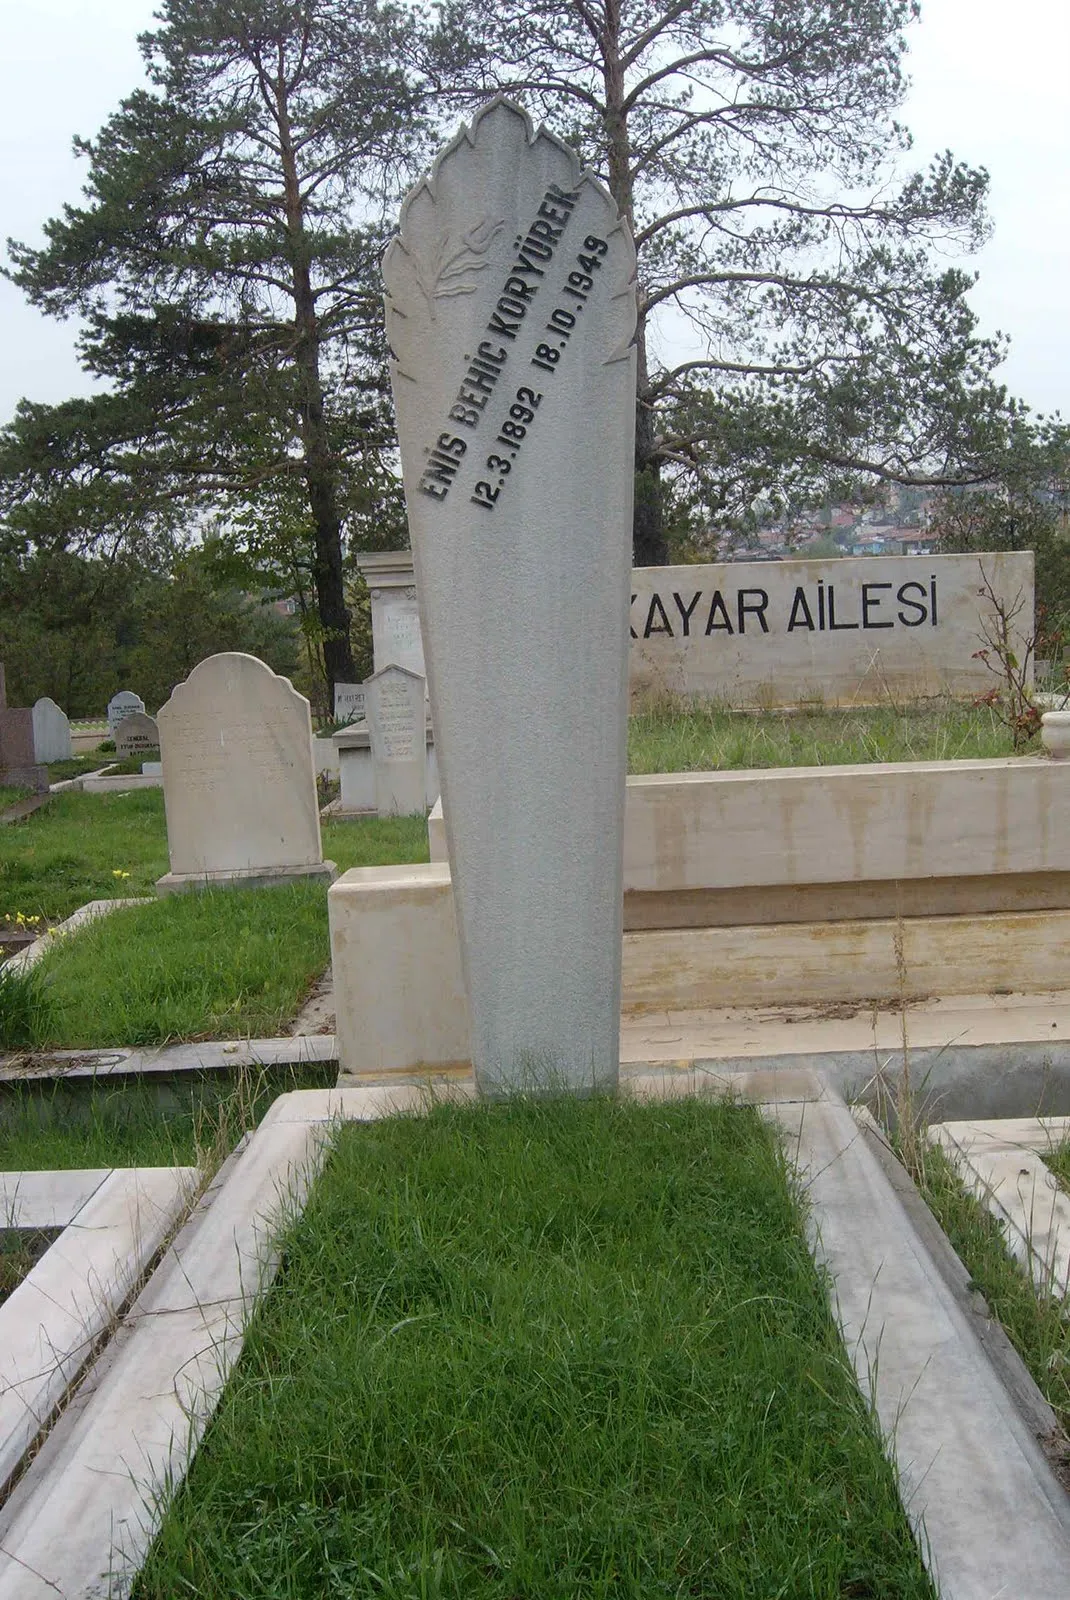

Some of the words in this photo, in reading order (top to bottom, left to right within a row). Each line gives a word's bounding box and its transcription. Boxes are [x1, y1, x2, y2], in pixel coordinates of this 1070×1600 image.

[418, 432, 468, 501] ENİS
[488, 184, 581, 340] KORYÜREK
[470, 386, 544, 511] 12.3.1892
[531, 235, 609, 373] 18.10.1949
[630, 589, 770, 639] AYAR
[787, 575, 938, 632] AİLESİ
